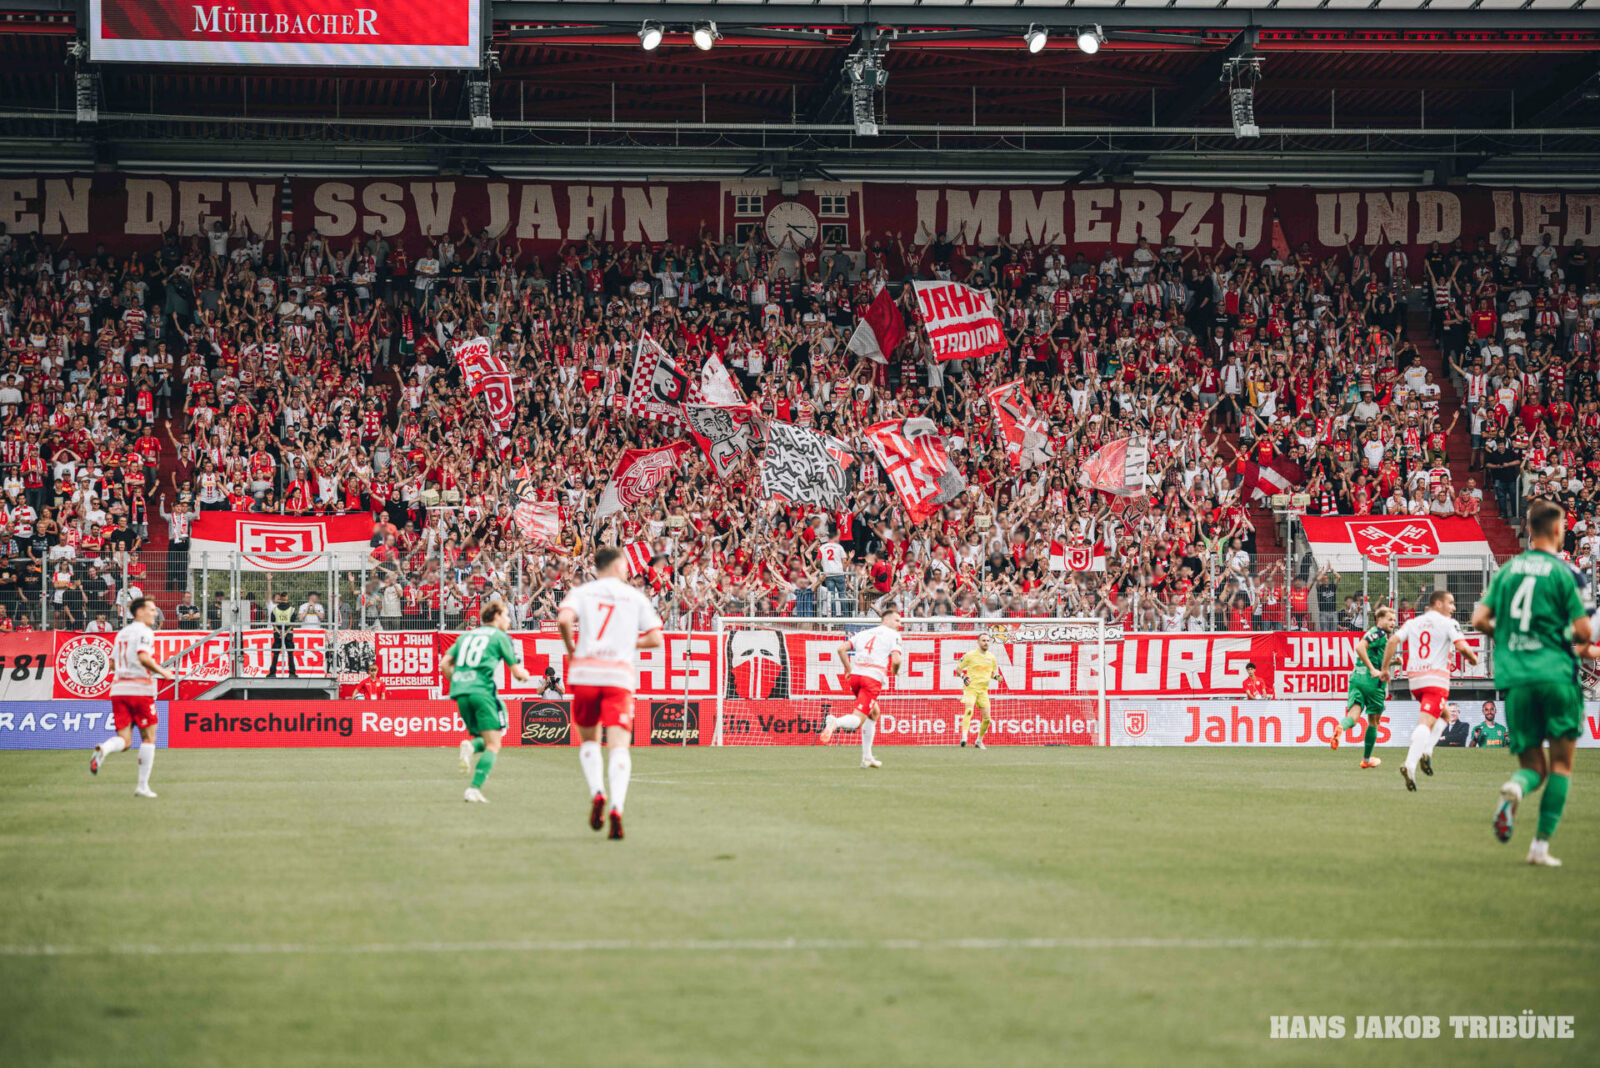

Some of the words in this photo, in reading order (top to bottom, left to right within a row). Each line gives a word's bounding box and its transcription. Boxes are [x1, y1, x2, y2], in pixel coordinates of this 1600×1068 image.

[192, 5, 380, 36] MÜHLBACHER
[124, 178, 275, 240] DEN
[313, 181, 456, 237] SSV
[484, 183, 668, 242] JAHN
[914, 188, 1267, 250] IMMERZU
[1316, 191, 1461, 247] UND
[918, 284, 990, 323] JAHN
[1510, 576, 1536, 632] 4
[597, 603, 615, 641] 7
[379, 634, 400, 645] SSV
[404, 634, 433, 646] JAHN
[457, 635, 489, 667] 18
[864, 636, 876, 655] 4
[1284, 637, 1361, 668] JAHN
[1418, 631, 1431, 659] 8
[12, 653, 47, 683] 81
[118, 641, 129, 669] 11
[379, 647, 434, 674] 1889
[805, 635, 1252, 692] RGENSBURG
[380, 676, 434, 686] REGENSBURG
[1284, 674, 1349, 693] STADIO
[184, 713, 353, 736] Fahrschulring
[362, 712, 466, 736] Regensb
[522, 723, 571, 739] Sterl
[651, 729, 699, 739] FISCHER
[758, 714, 856, 733] Verbu
[880, 714, 946, 734] Deine
[954, 714, 1099, 734] Fahrschulen
[1184, 706, 1282, 743] Jahn
